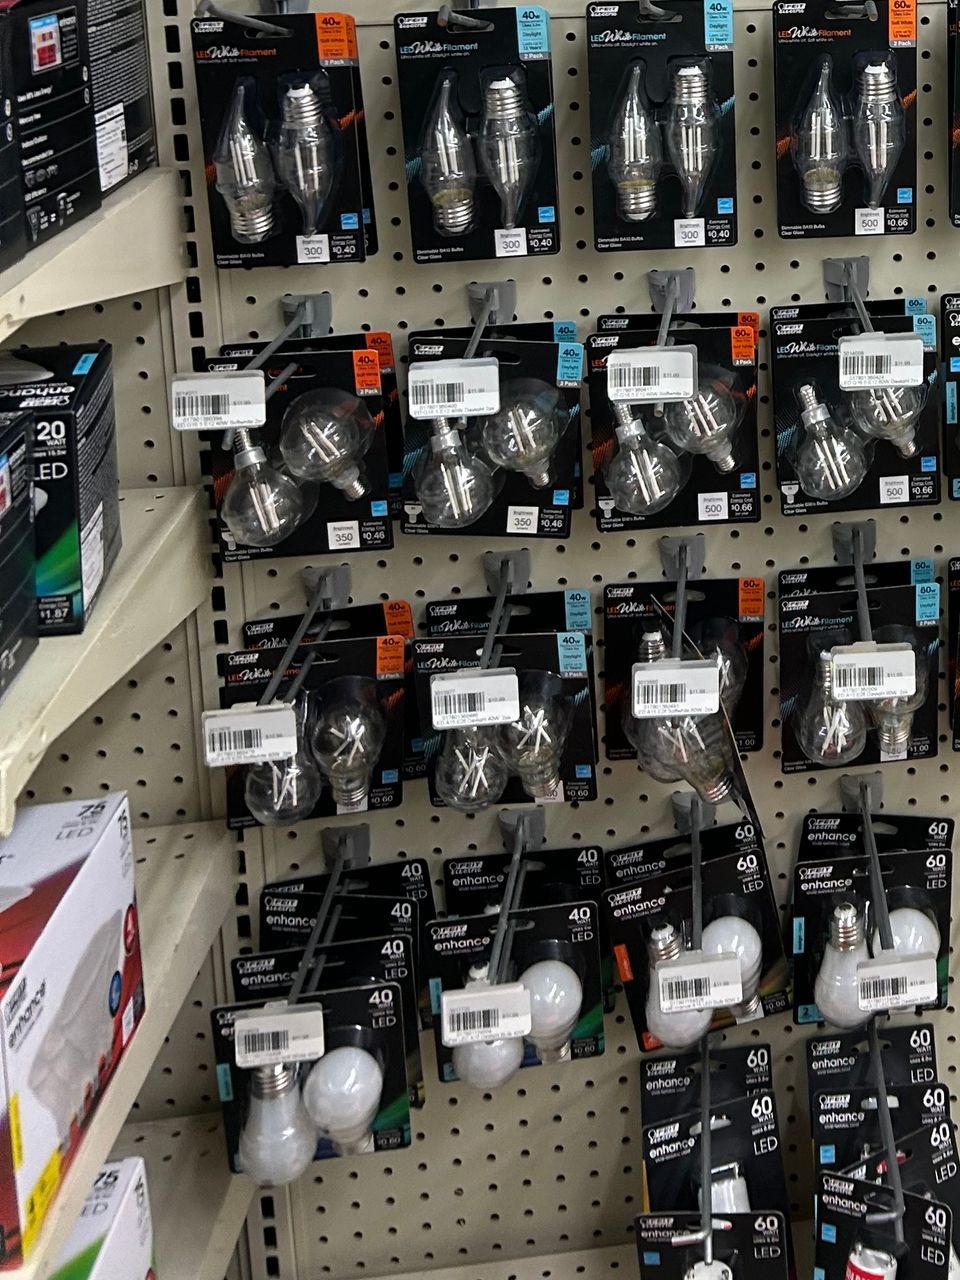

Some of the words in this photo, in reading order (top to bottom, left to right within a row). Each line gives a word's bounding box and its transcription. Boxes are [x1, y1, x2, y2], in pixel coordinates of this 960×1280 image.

[893, 0, 911, 9] 60w
[522, 11, 540, 20] 40w
[601, 30, 633, 42] White
[530, 238, 552, 247] $0.40
[37, 420, 66, 440] 20
[336, 532, 353, 542] 350
[362, 531, 385, 540] $0.46
[577, 850, 598, 863] 40
[736, 855, 757, 871] 60
[926, 854, 946, 868] 60
[401, 863, 422, 878] 40
[453, 874, 504, 887] enhance
[801, 878, 852, 891] enhance
[926, 880, 947, 889] LED
[391, 903, 411, 918] 40
[569, 907, 591, 920] 40
[435, 936, 490, 951] enhance
[571, 932, 593, 942] LED
[381, 940, 404, 955] 40
[369, 989, 392, 1005] 40
[910, 1029, 931, 1049] 60
[746, 1049, 768, 1068] 60
[910, 1068, 934, 1084] LED
[923, 1089, 945, 1108] 60
[751, 1096, 772, 1118] 60
[819, 1111, 865, 1124] enhance
[930, 1123, 950, 1147] 60
[649, 1137, 695, 1159] enhance
[753, 1136, 778, 1156] LED
[934, 1161, 957, 1184] LED
[822, 1194, 867, 1213] enhance
[754, 1216, 778, 1231] 60
[925, 1206, 946, 1228] 60
[921, 1244, 945, 1266] LED
